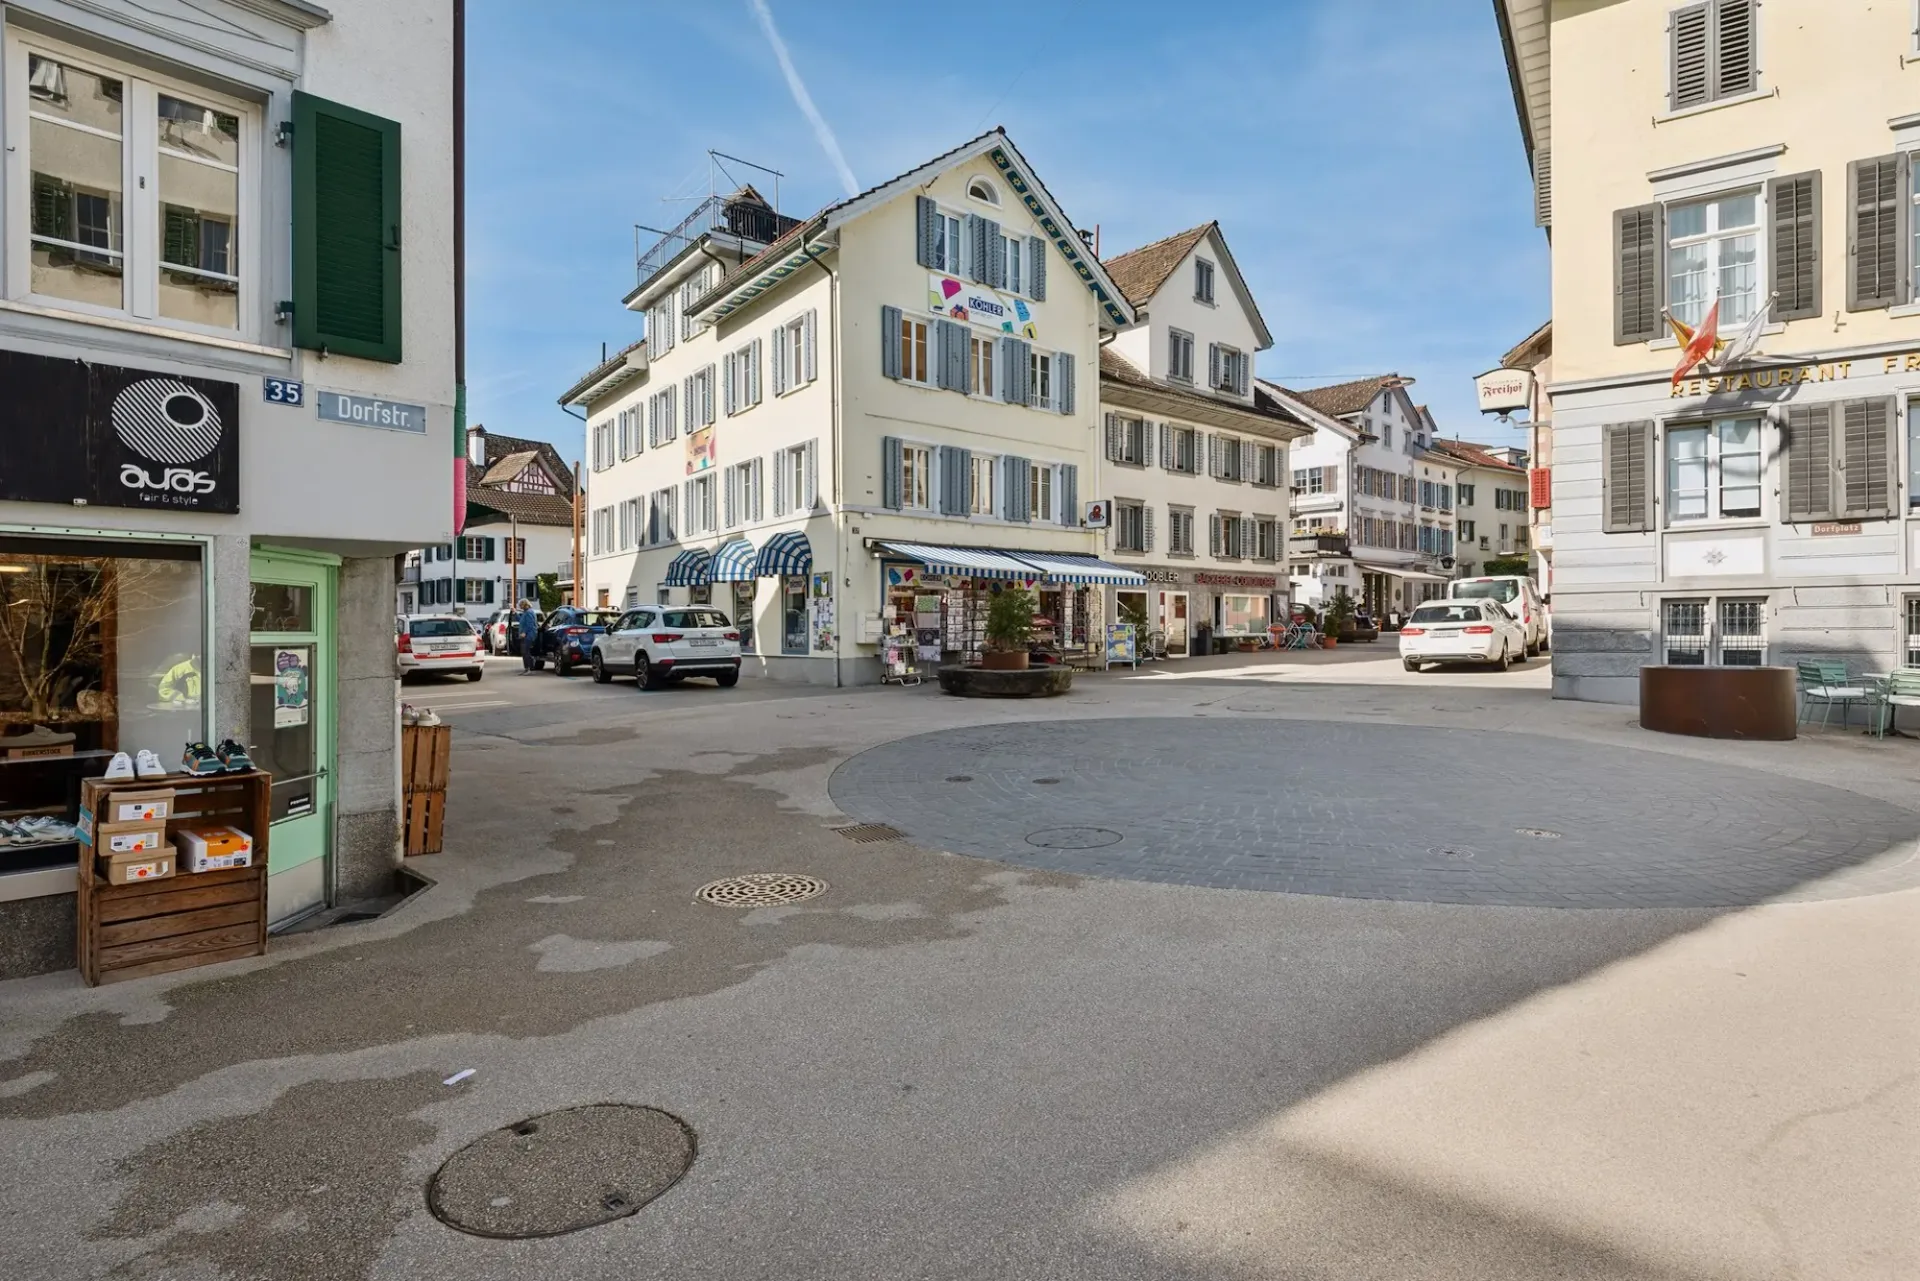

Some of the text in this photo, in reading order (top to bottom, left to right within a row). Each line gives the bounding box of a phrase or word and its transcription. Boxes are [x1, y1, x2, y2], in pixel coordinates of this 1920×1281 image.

[1670, 361, 1852, 398] RESTAURANT
[270, 381, 299, 403] 35
[1483, 383, 1522, 397] Freihof
[338, 396, 411, 428] Dorfstr.
[139, 492, 198, 506] fair & style
[1814, 524, 1859, 533] Dorfplatz
[1146, 570, 1179, 582] DOBLER
